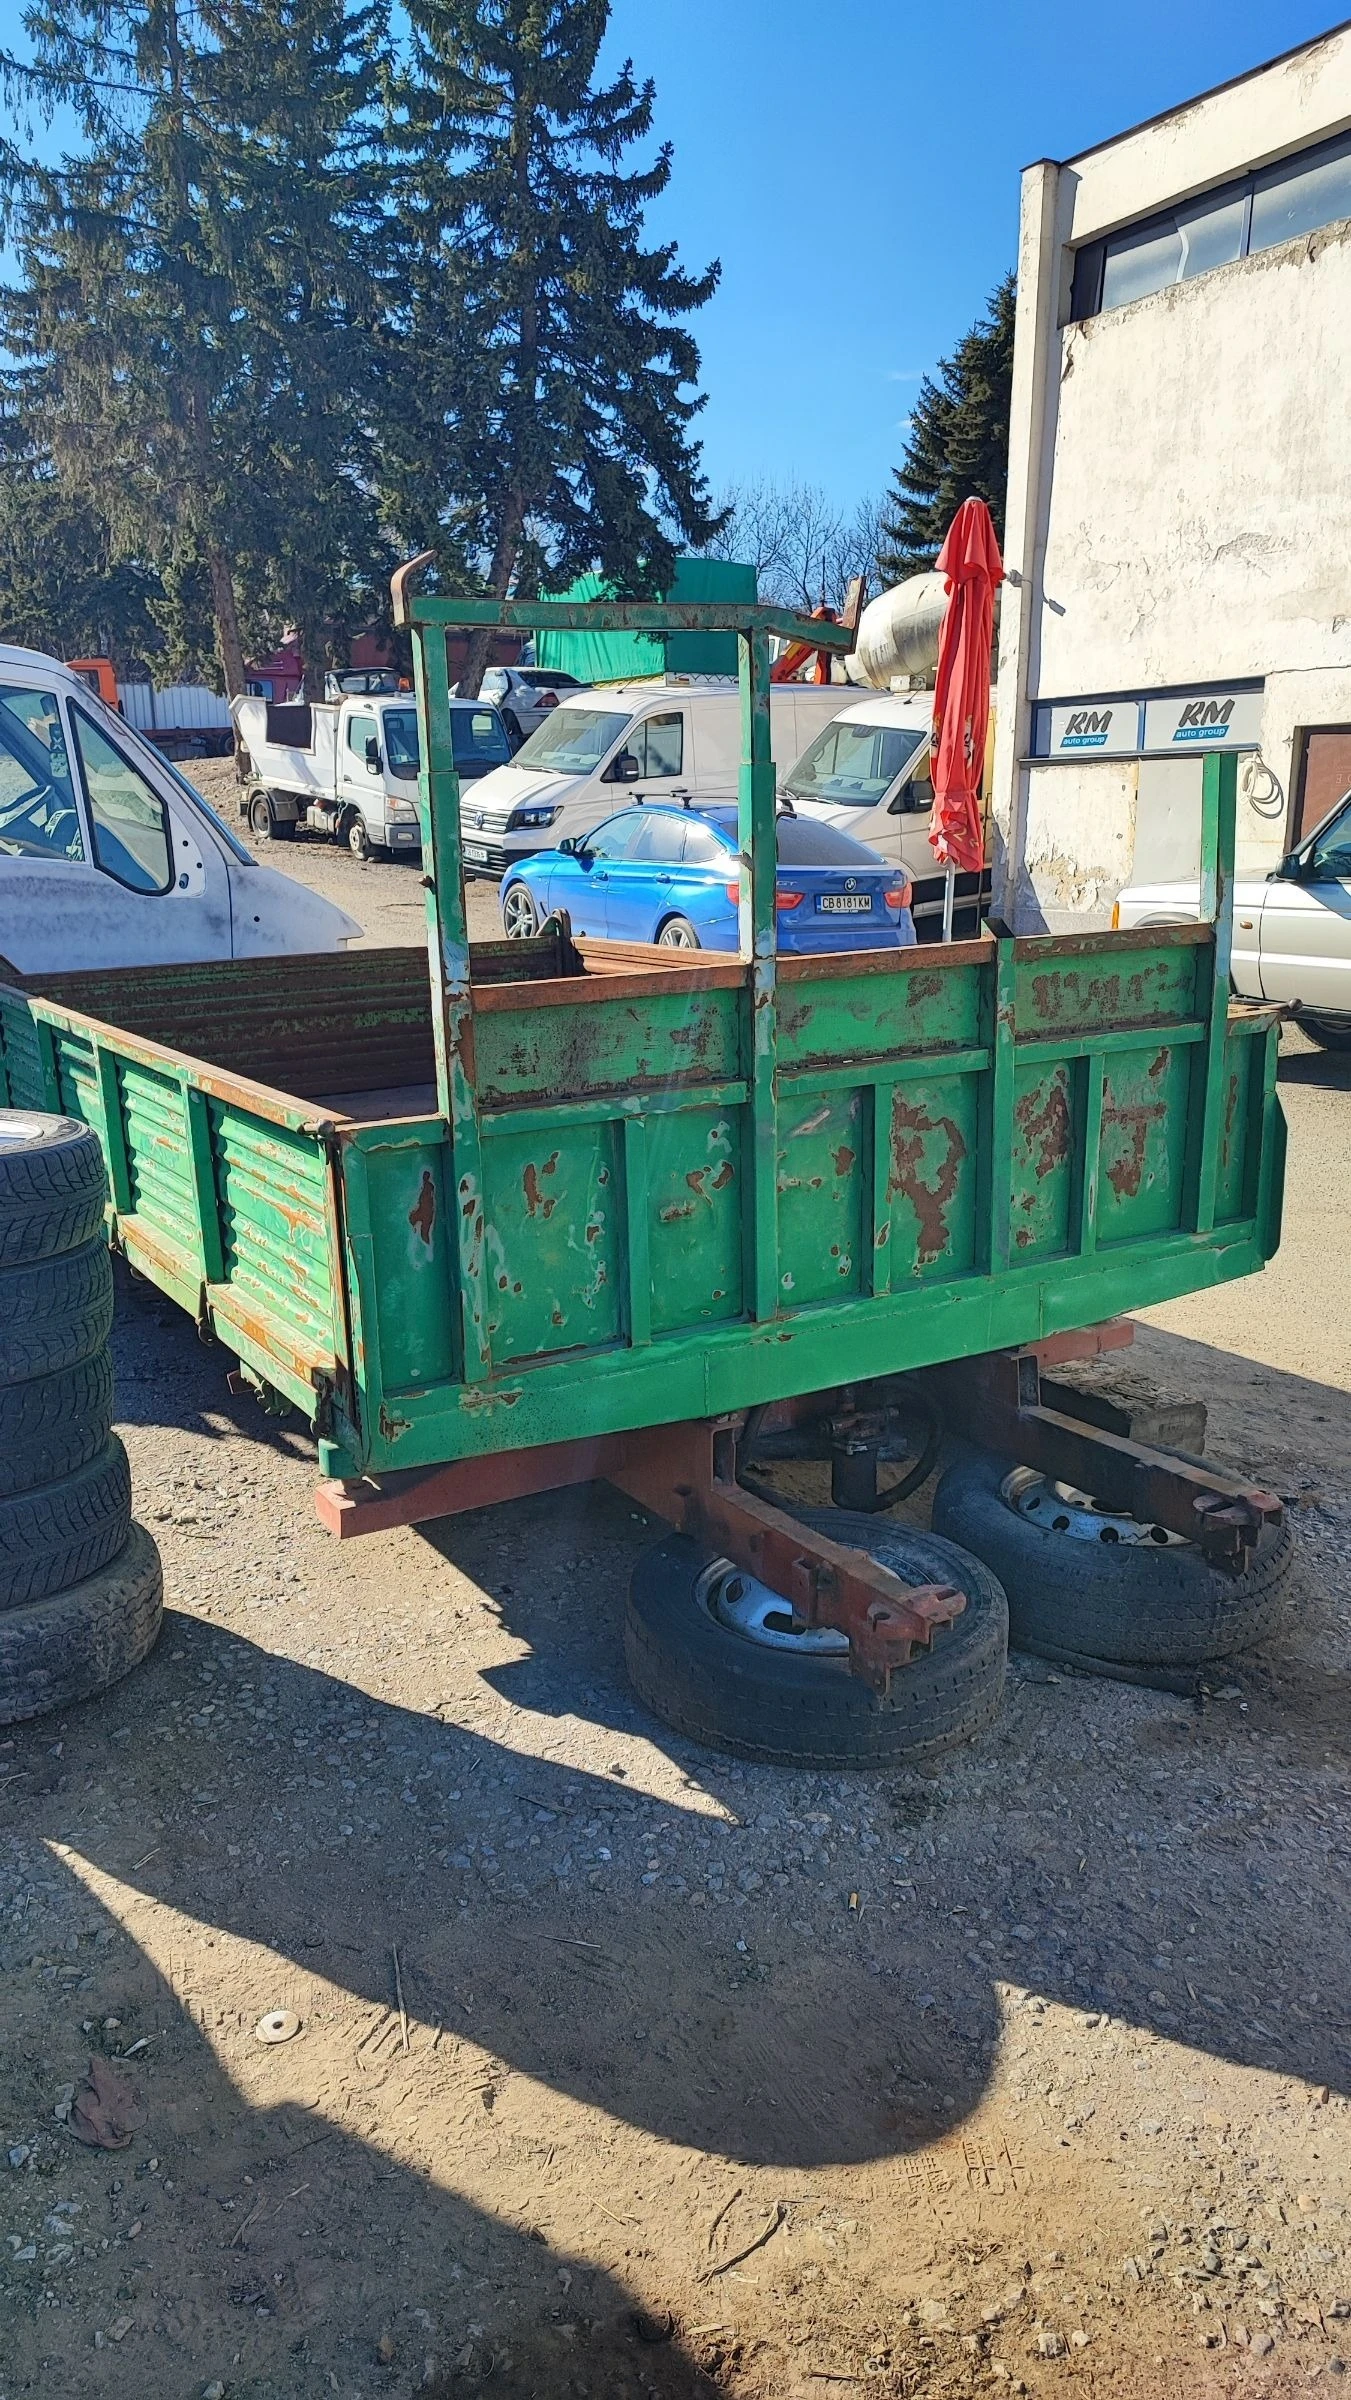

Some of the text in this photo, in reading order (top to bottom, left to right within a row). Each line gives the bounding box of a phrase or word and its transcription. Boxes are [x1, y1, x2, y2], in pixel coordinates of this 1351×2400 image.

[1176, 728, 1225, 738] auto group
[1082, 736, 1105, 745] group
